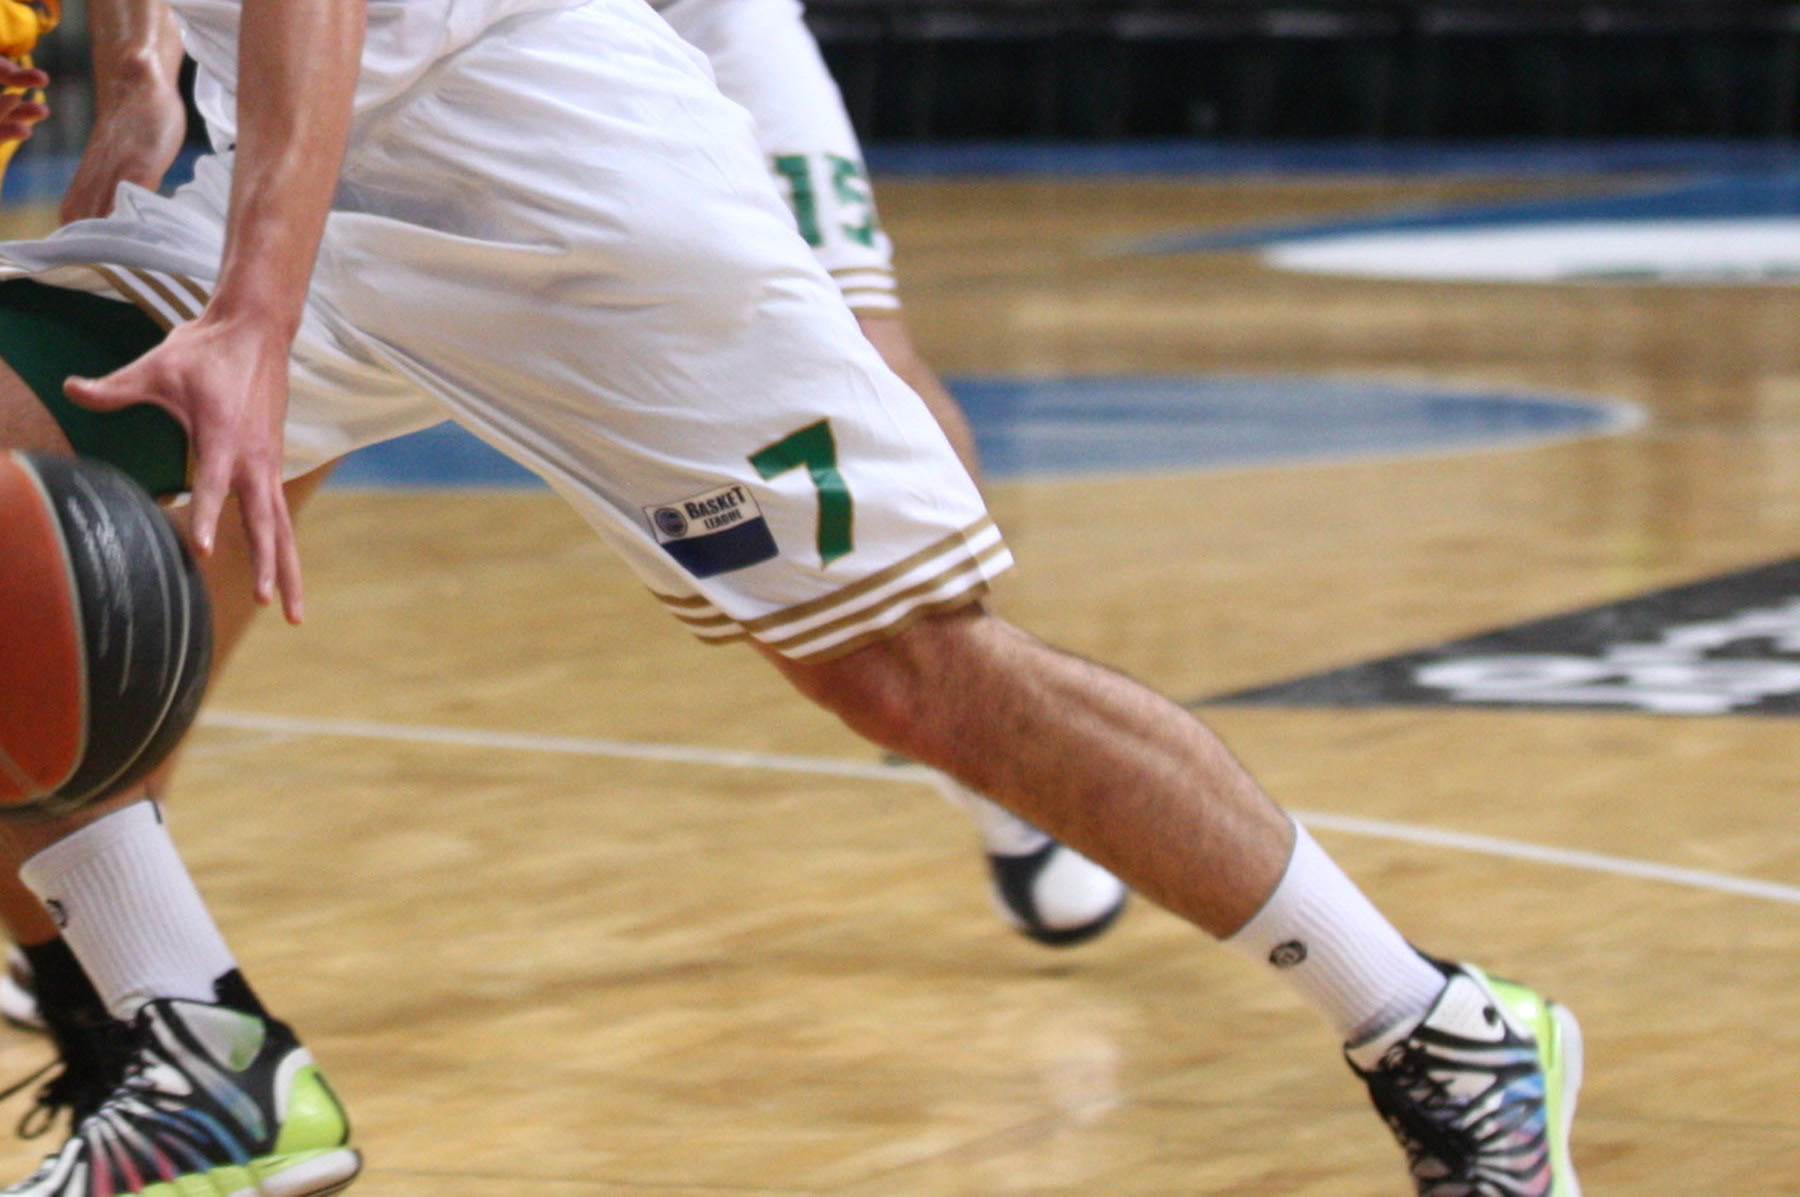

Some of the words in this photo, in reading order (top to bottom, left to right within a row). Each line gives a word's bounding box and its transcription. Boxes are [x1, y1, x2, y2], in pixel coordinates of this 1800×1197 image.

[770, 152, 878, 248] 15
[684, 487, 746, 521] BASKET
[747, 417, 855, 570] 7
